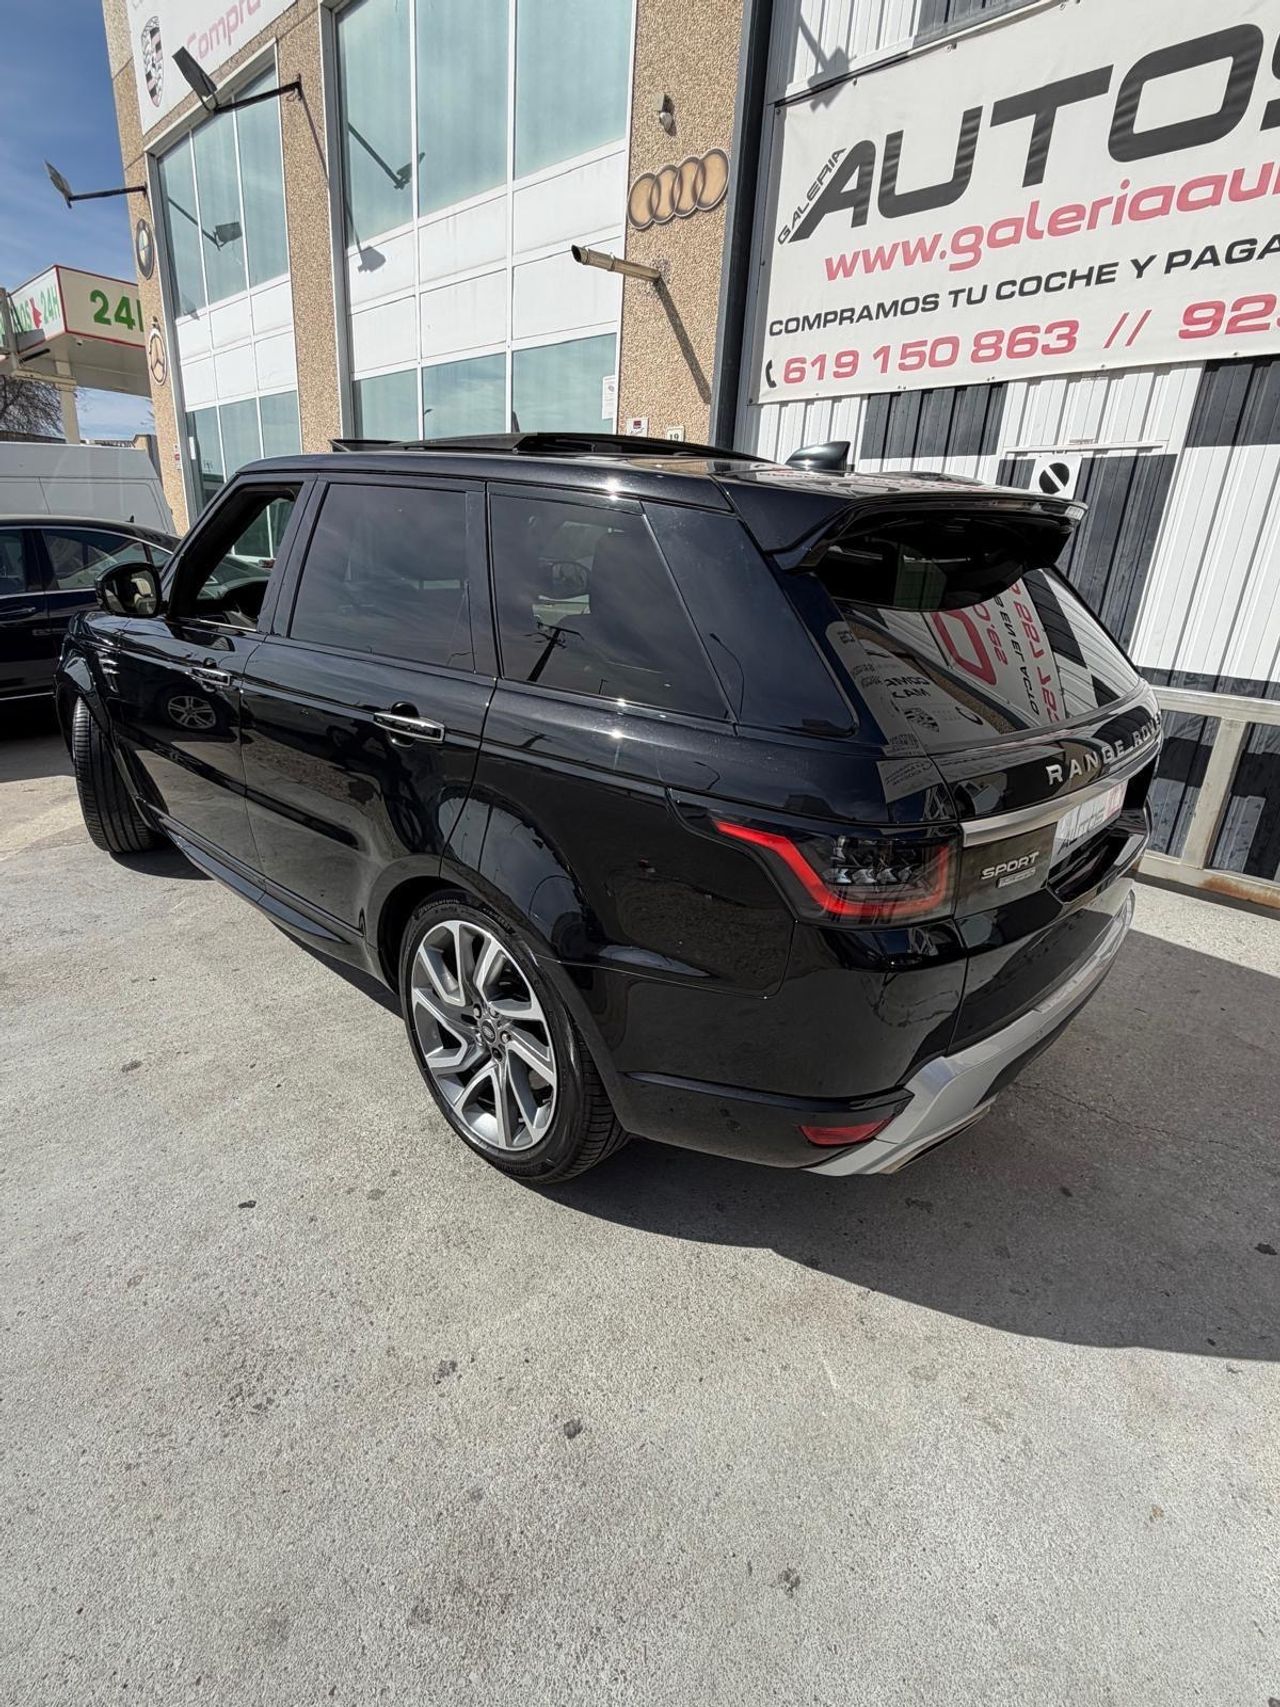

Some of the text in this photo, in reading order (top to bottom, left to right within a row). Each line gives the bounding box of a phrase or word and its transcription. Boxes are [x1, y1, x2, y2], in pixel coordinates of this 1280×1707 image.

[777, 147, 847, 244] GALERIA
[824, 162, 1280, 281] www.galeriaau
[89, 289, 144, 332] 24
[769, 293, 939, 336] COMPRAMOS
[948, 284, 987, 308] TU
[995, 262, 1119, 300] COCHE
[1130, 254, 1157, 279] Y
[783, 349, 859, 384] 619
[873, 335, 960, 374] 150
[970, 320, 1079, 363] 863
[1178, 294, 1280, 340] 92
[1046, 740, 1126, 785] RANGE
[981, 851, 1039, 880] SPORT
